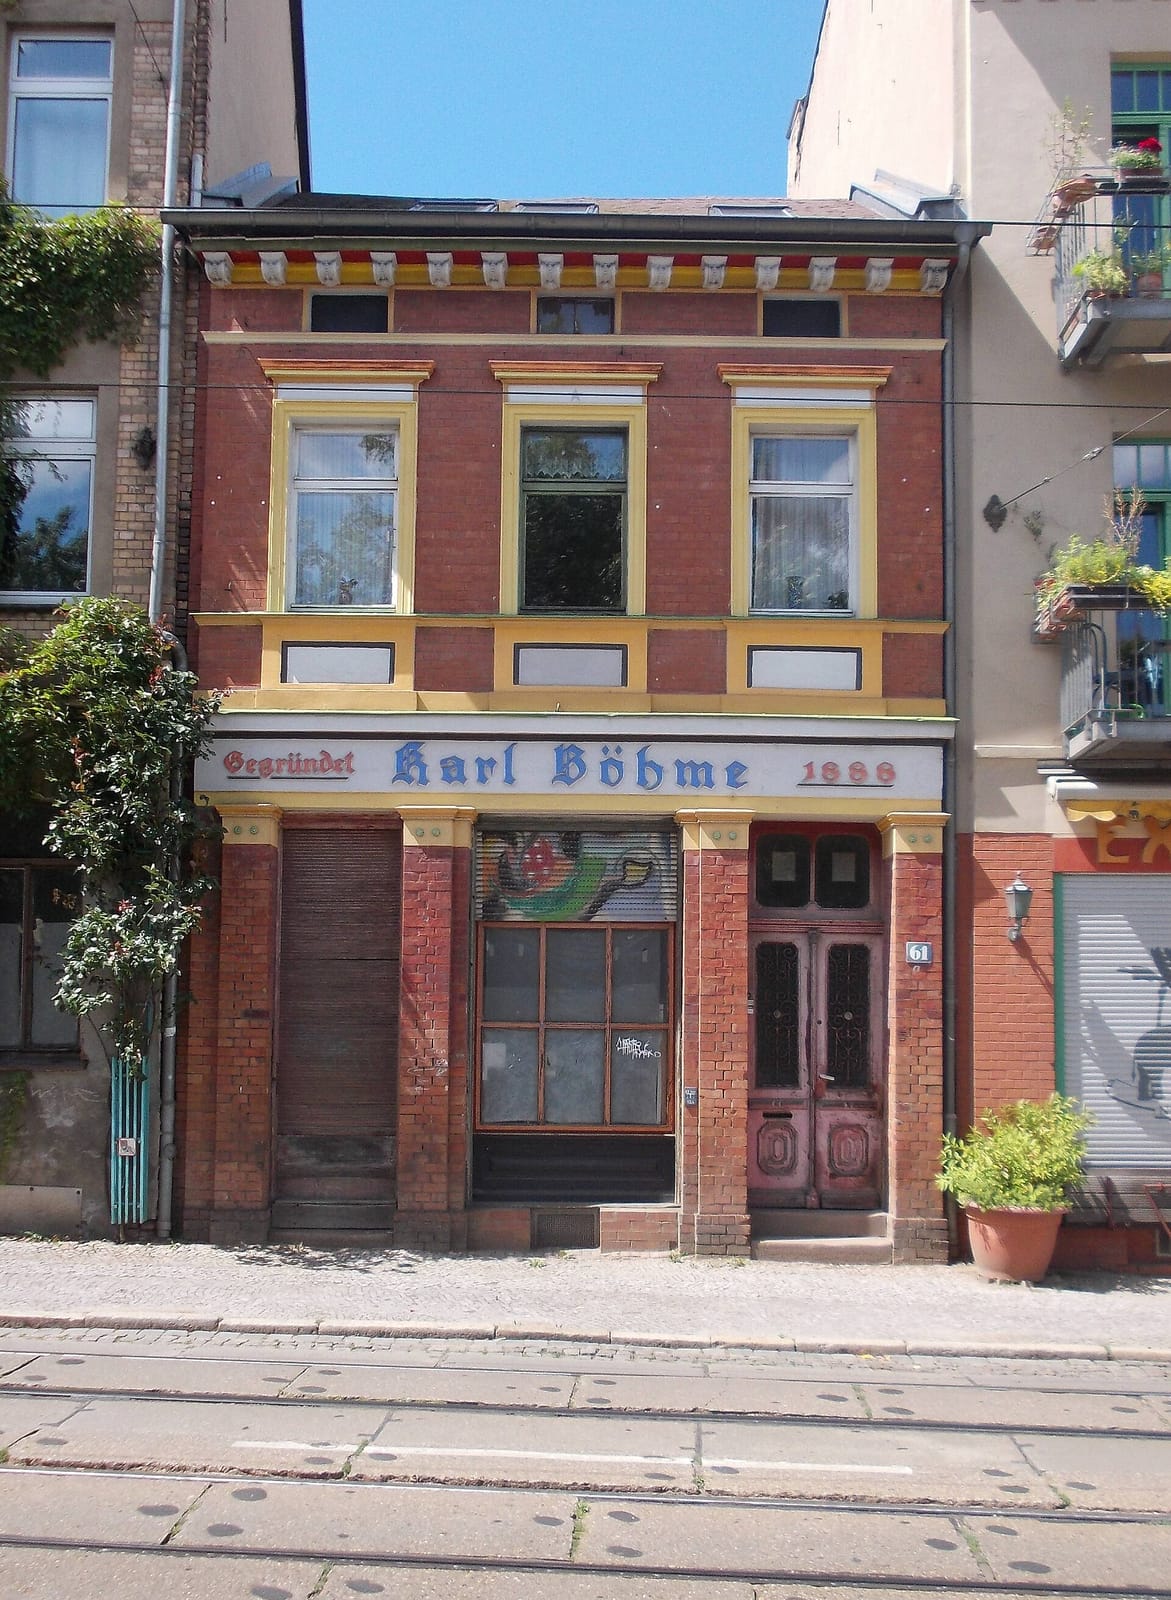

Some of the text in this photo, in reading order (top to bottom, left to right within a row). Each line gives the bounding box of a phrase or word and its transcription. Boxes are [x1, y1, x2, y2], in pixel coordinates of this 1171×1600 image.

[223, 750, 356, 779] Gegründet
[391, 741, 749, 791] Karl Böhme
[801, 761, 897, 784] 1888
[909, 944, 929, 961] 61
